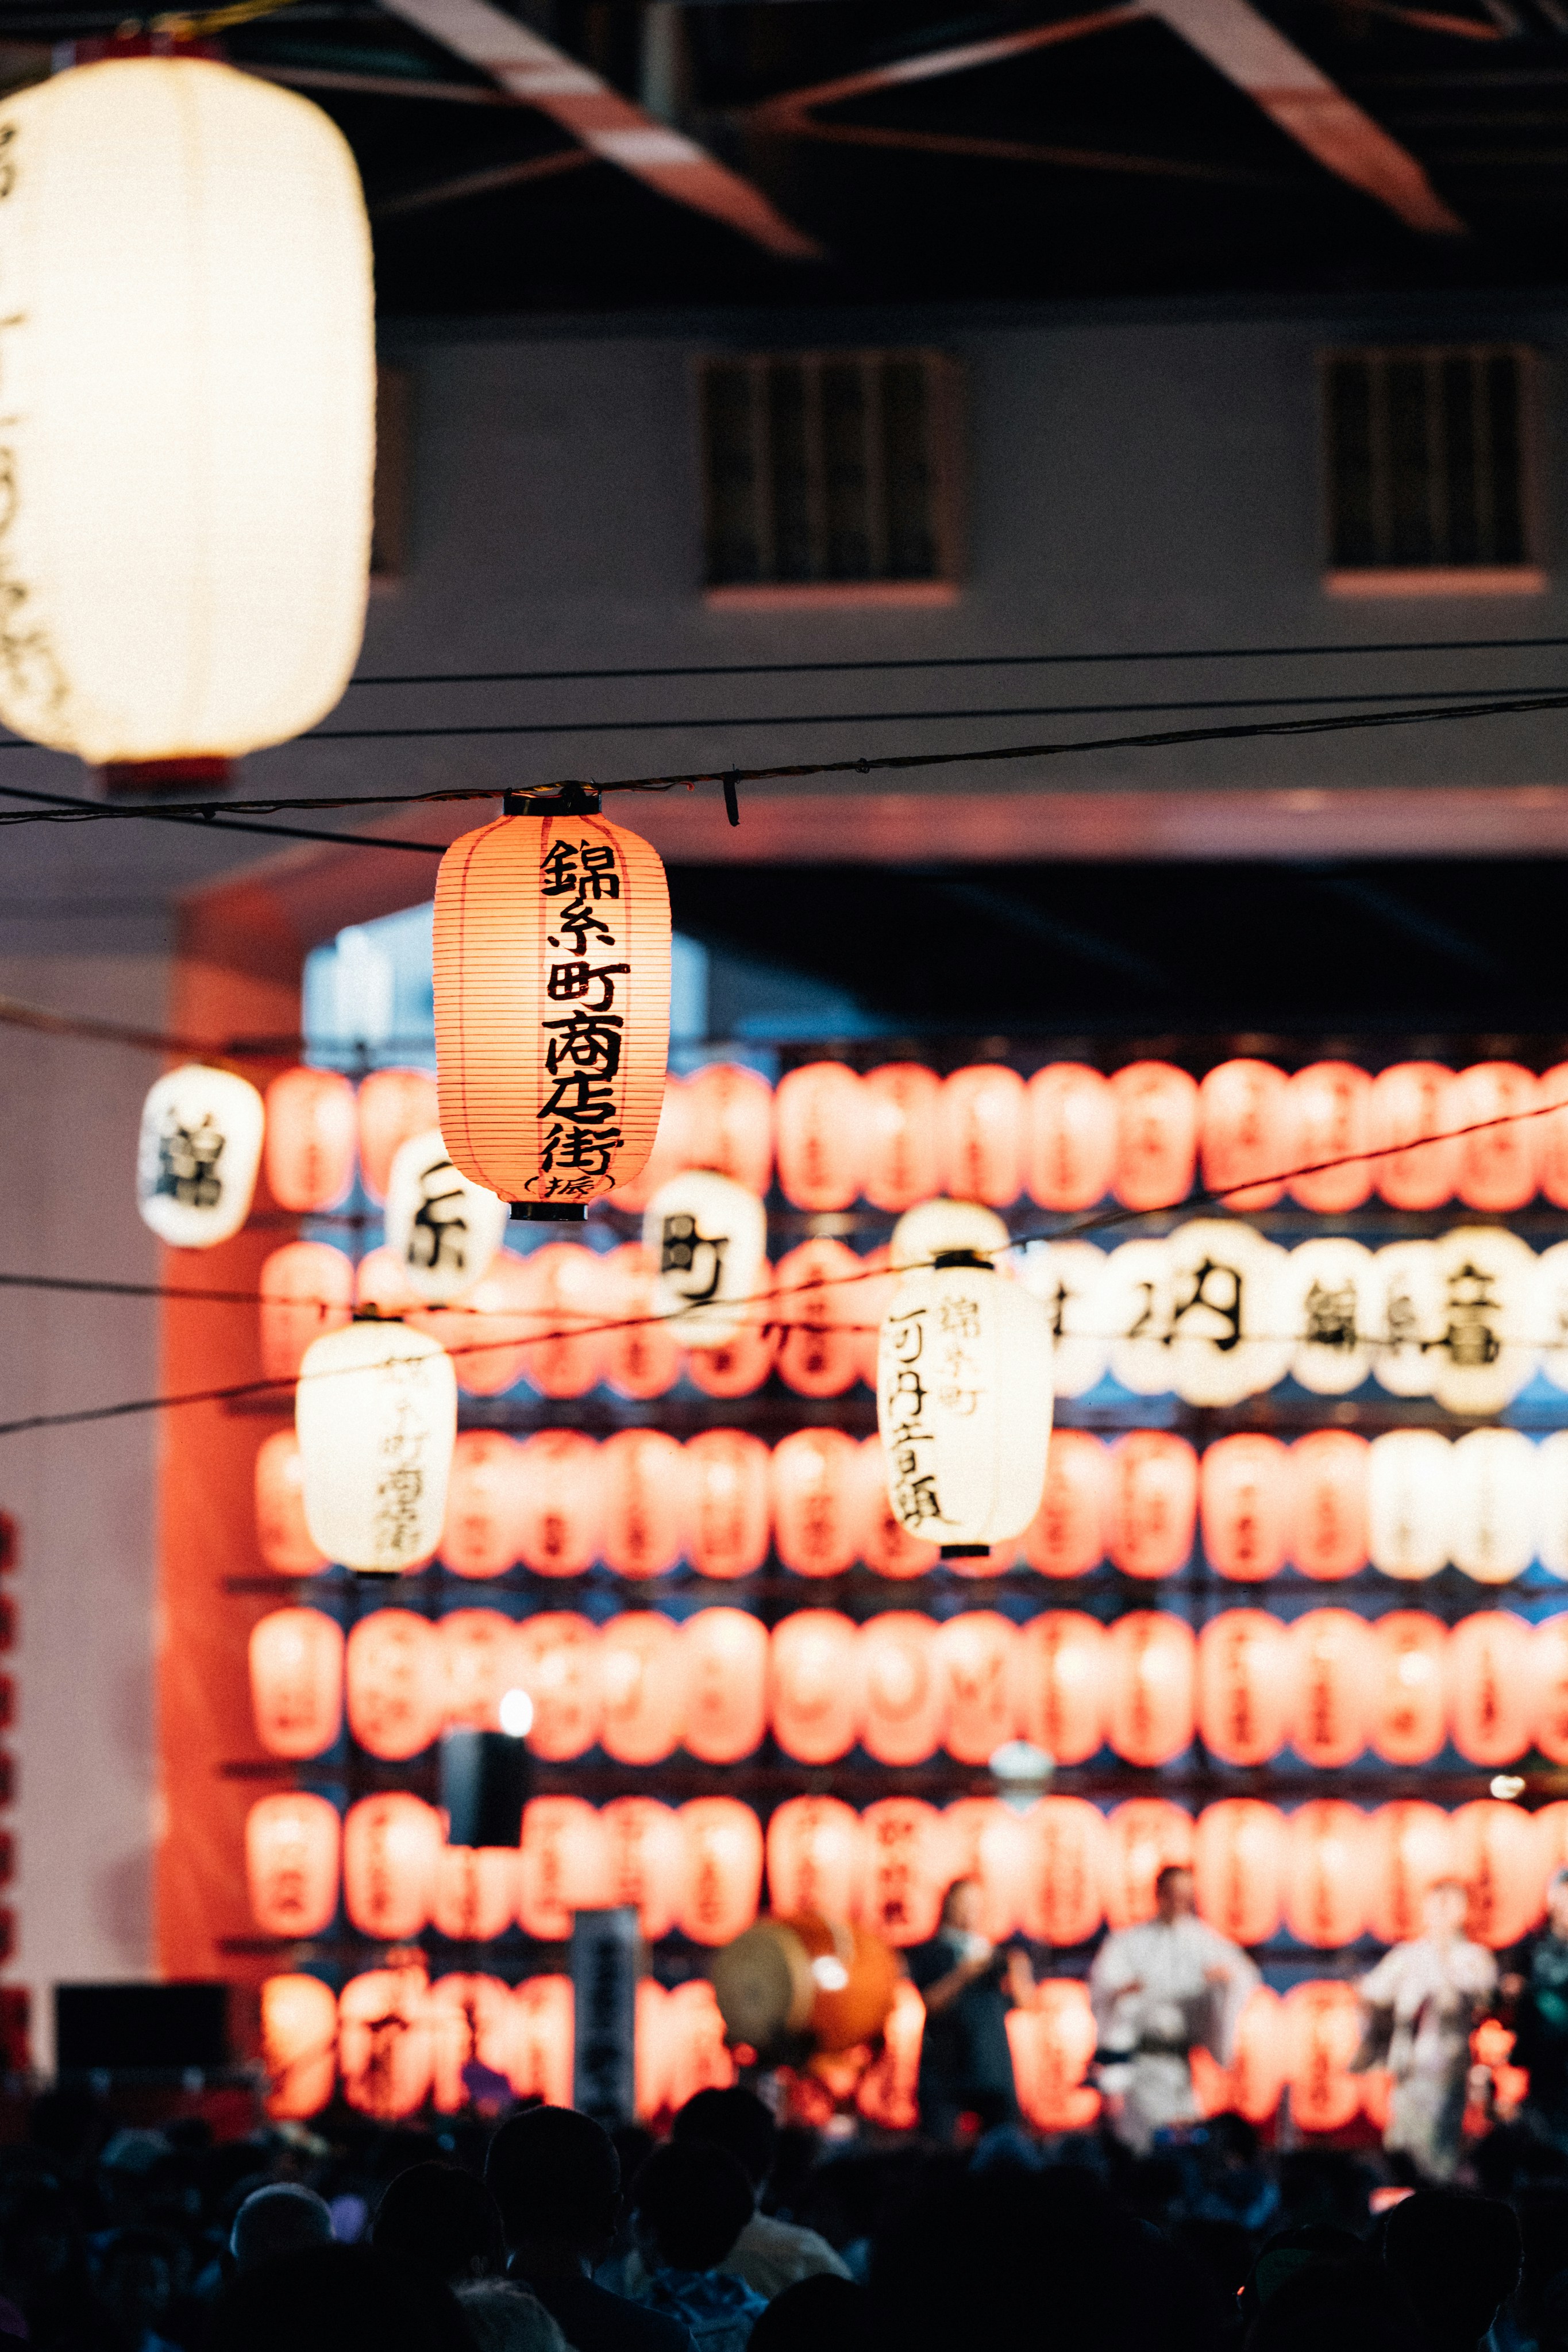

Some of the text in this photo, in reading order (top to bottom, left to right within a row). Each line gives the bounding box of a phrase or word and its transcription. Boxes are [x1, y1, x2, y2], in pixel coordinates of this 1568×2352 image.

[537, 839, 630, 1176] 錦糸町商店街
[662, 1214, 728, 1302] 町
[1164, 1260, 1242, 1352] 内
[938, 1294, 984, 1417] 錦糸町
